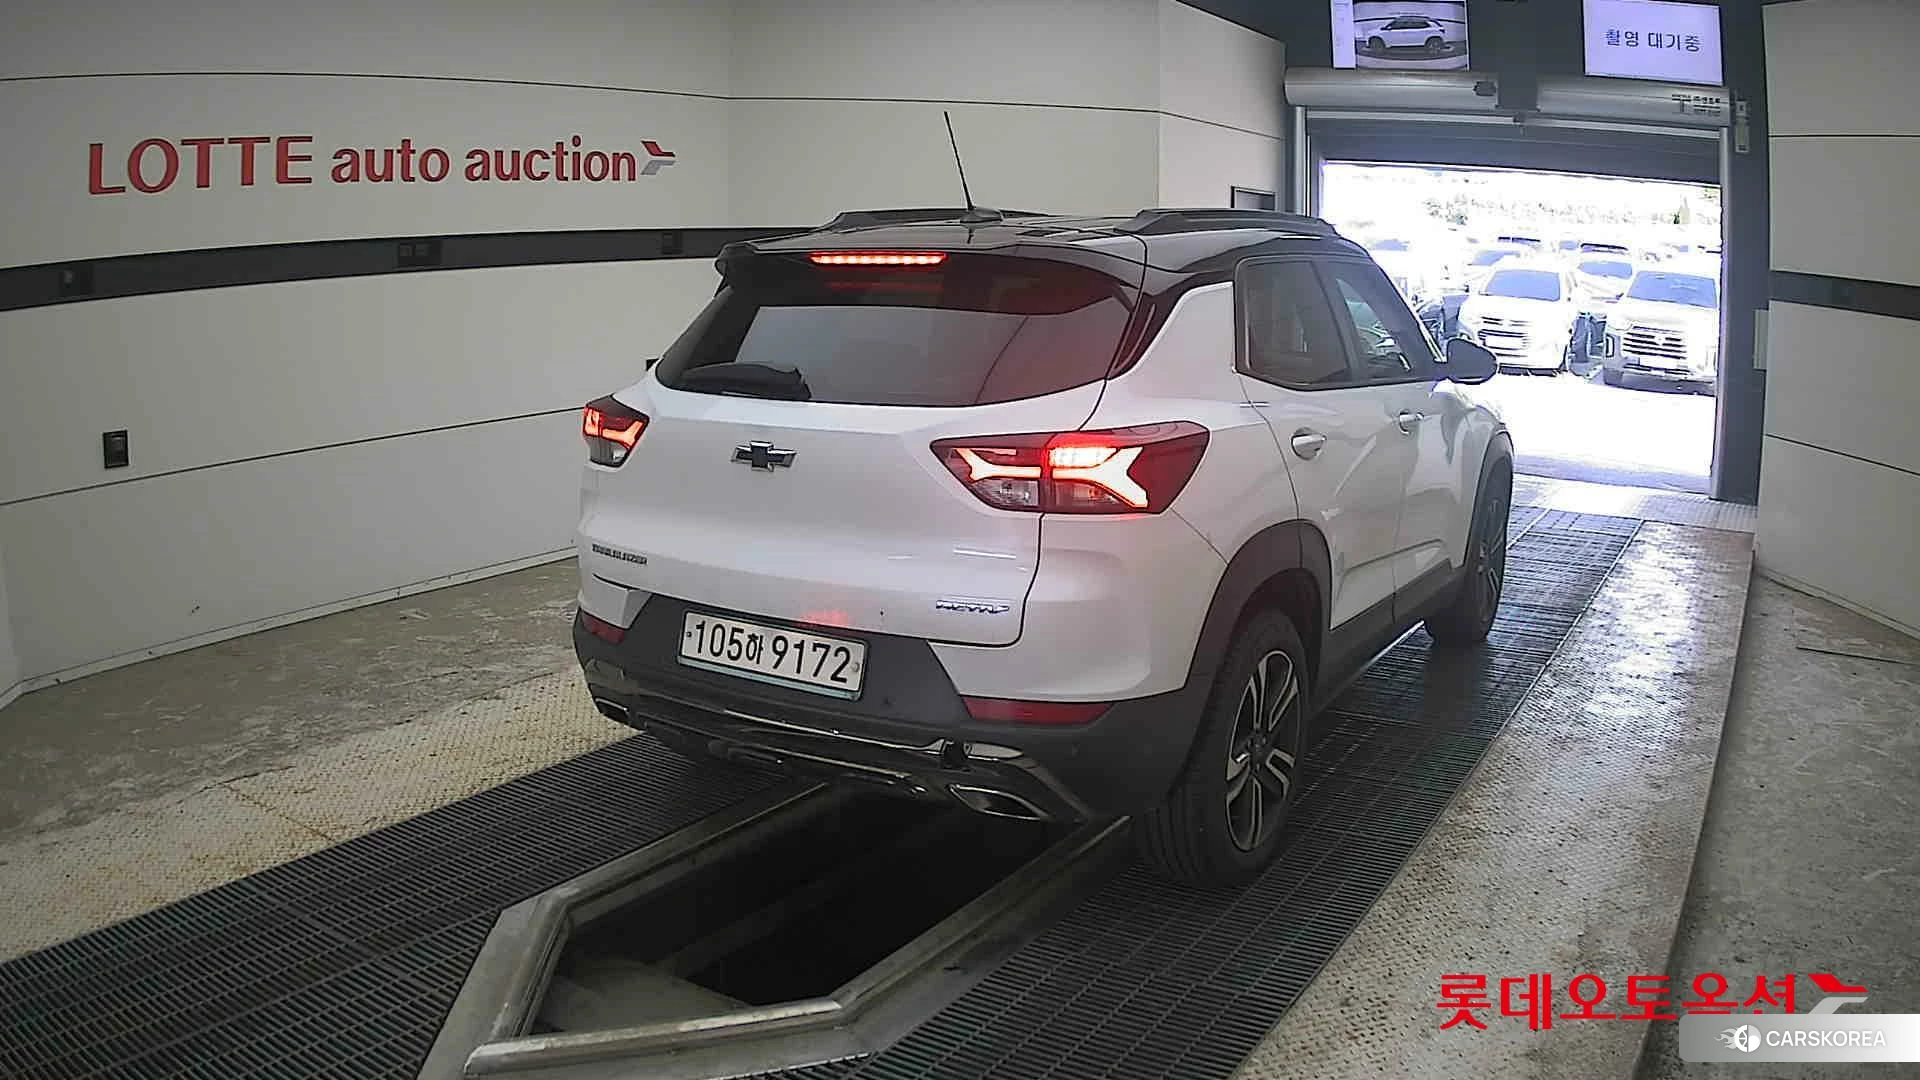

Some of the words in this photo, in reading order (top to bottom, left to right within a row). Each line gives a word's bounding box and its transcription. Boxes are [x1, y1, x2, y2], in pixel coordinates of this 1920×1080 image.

[1647, 32, 1700, 52] 대기중
[88, 136, 314, 195] LOTTE
[331, 138, 450, 183] auto
[464, 135, 638, 182] auction
[772, 635, 850, 683] 9172
